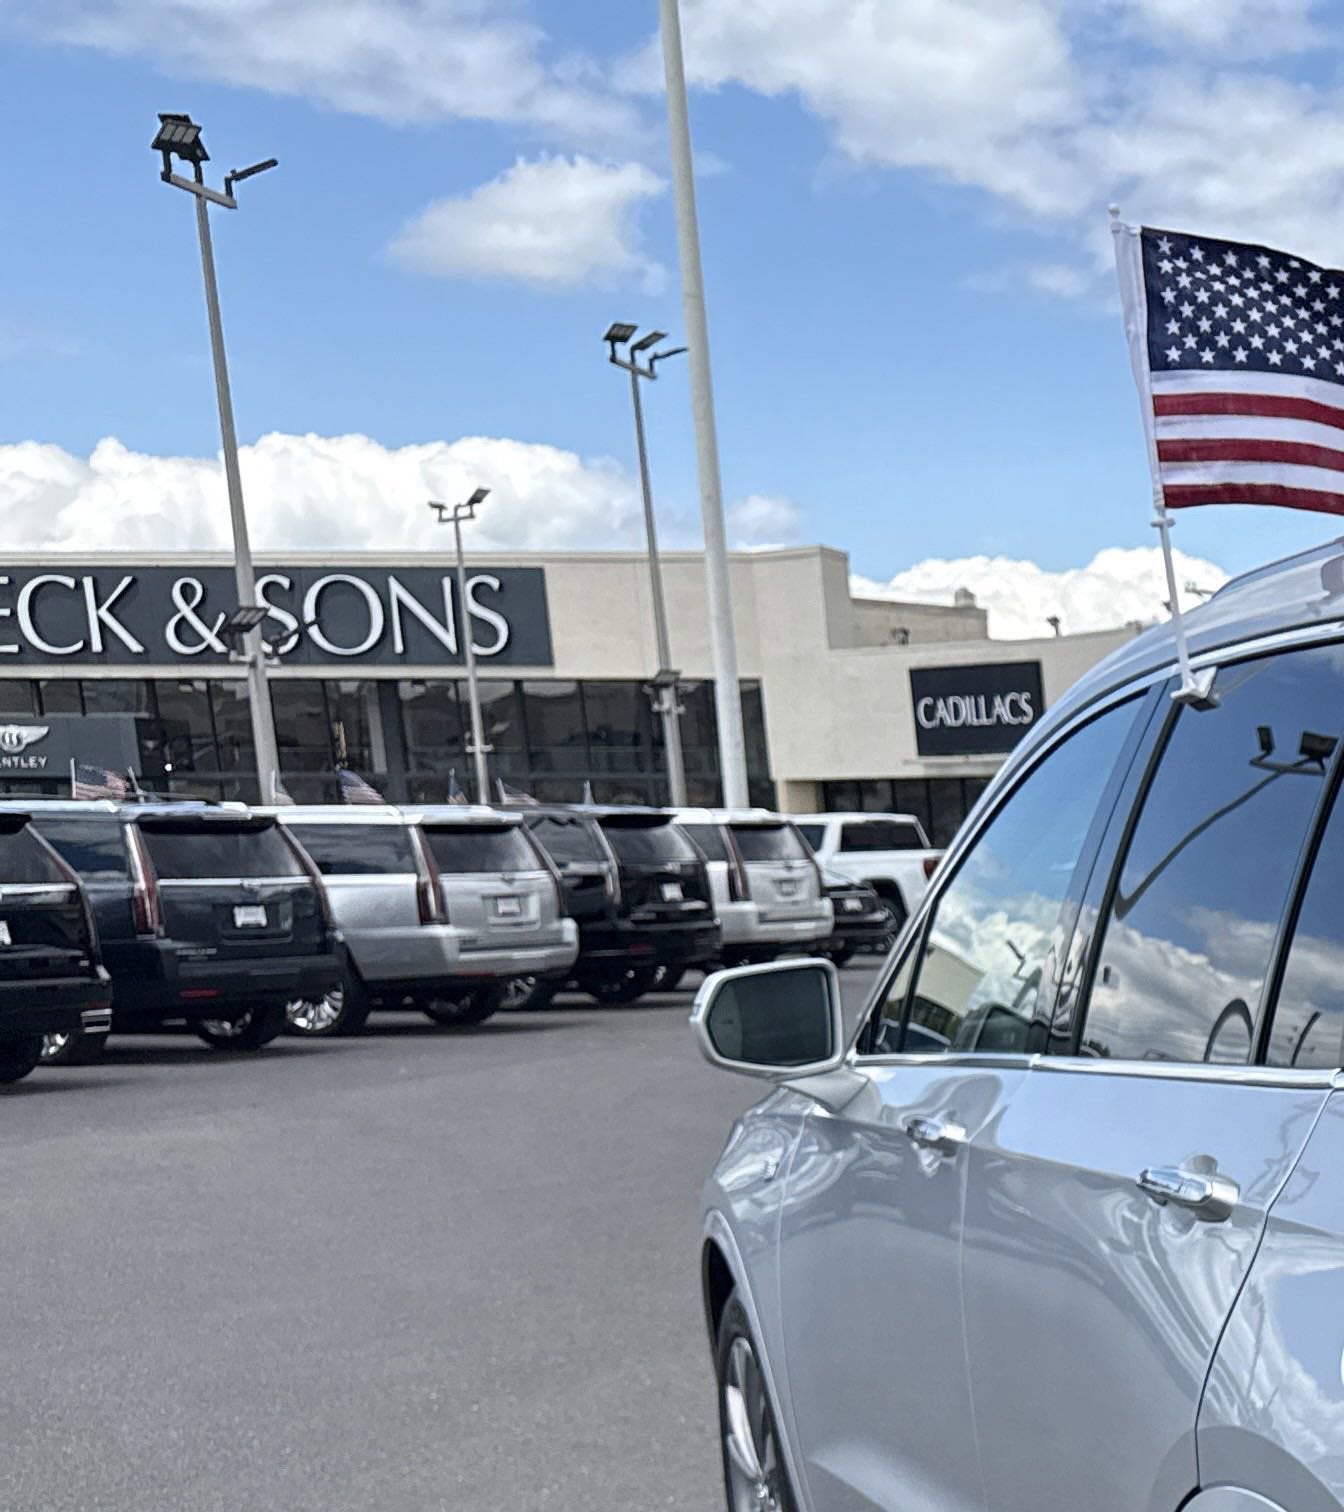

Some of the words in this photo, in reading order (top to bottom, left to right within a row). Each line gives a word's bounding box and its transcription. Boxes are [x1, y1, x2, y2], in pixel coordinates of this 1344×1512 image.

[165, 577, 228, 654] &
[255, 574, 509, 655] SONS
[917, 691, 1034, 729] CADILLACS
[0, 756, 47, 769] NTLEY
